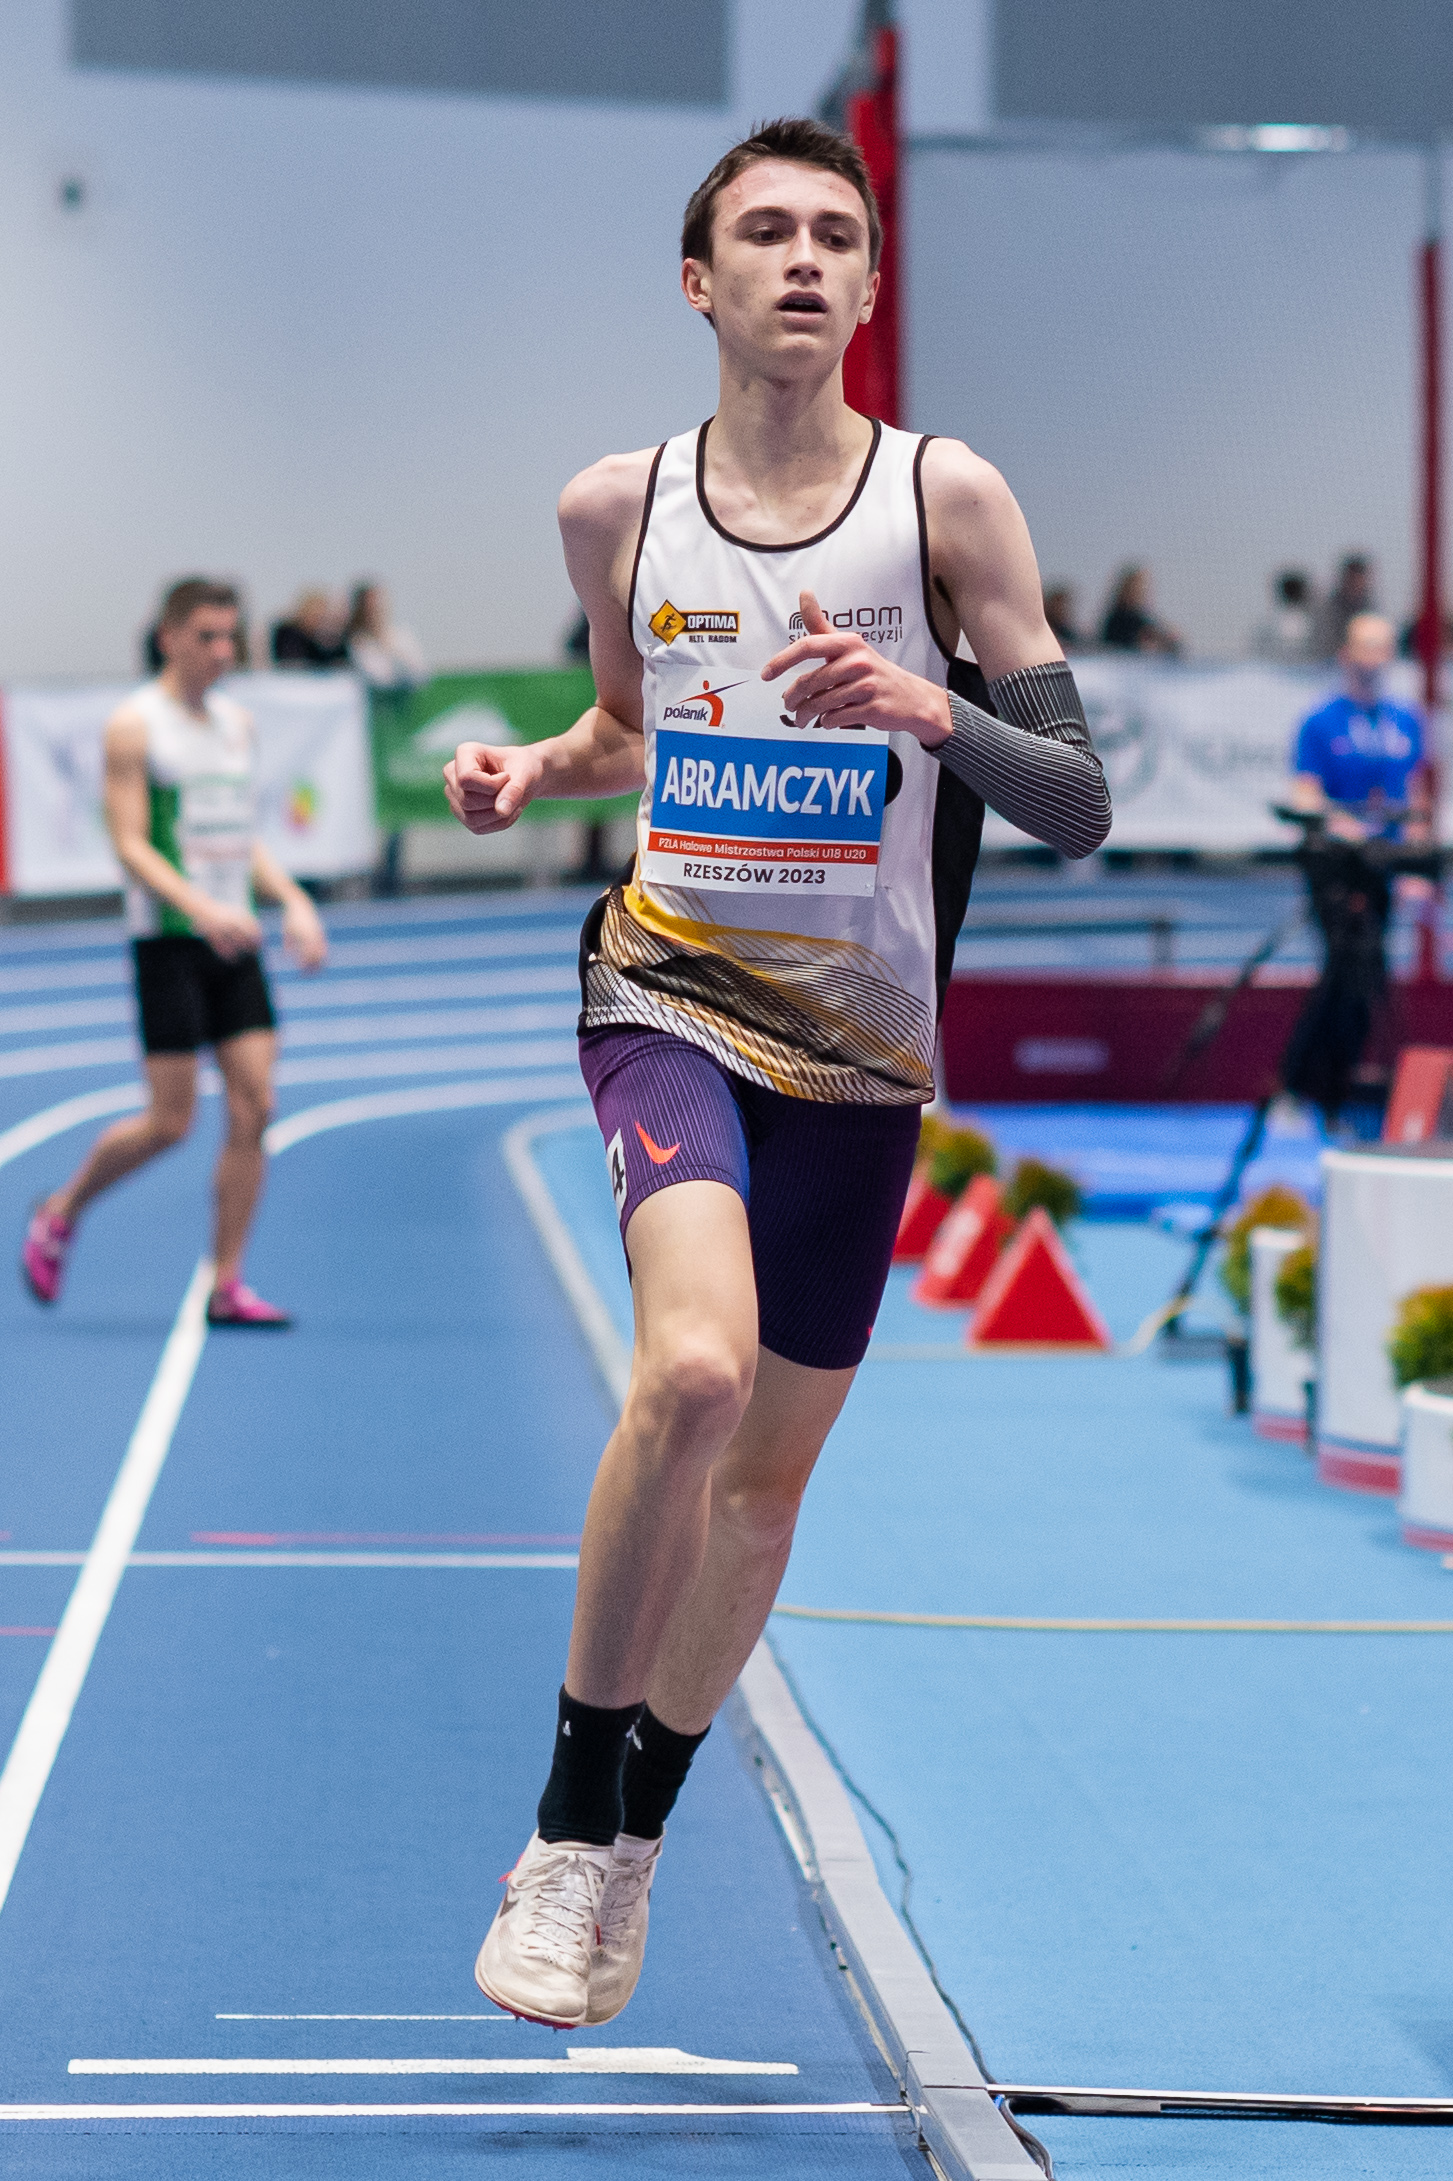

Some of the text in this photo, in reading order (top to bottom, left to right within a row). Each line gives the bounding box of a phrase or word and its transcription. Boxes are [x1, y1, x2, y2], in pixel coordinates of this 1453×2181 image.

[687, 615, 737, 629] OPTIMA
[708, 635, 737, 643] RADOM
[856, 626, 903, 643] ecyzji
[663, 705, 708, 721] polanik
[660, 756, 875, 817] ABRAMCZYK
[658, 837, 867, 859] PZLA Halowe Mistrzostwa Polski U18 U20
[683, 862, 826, 884] RZESZÓW 2023
